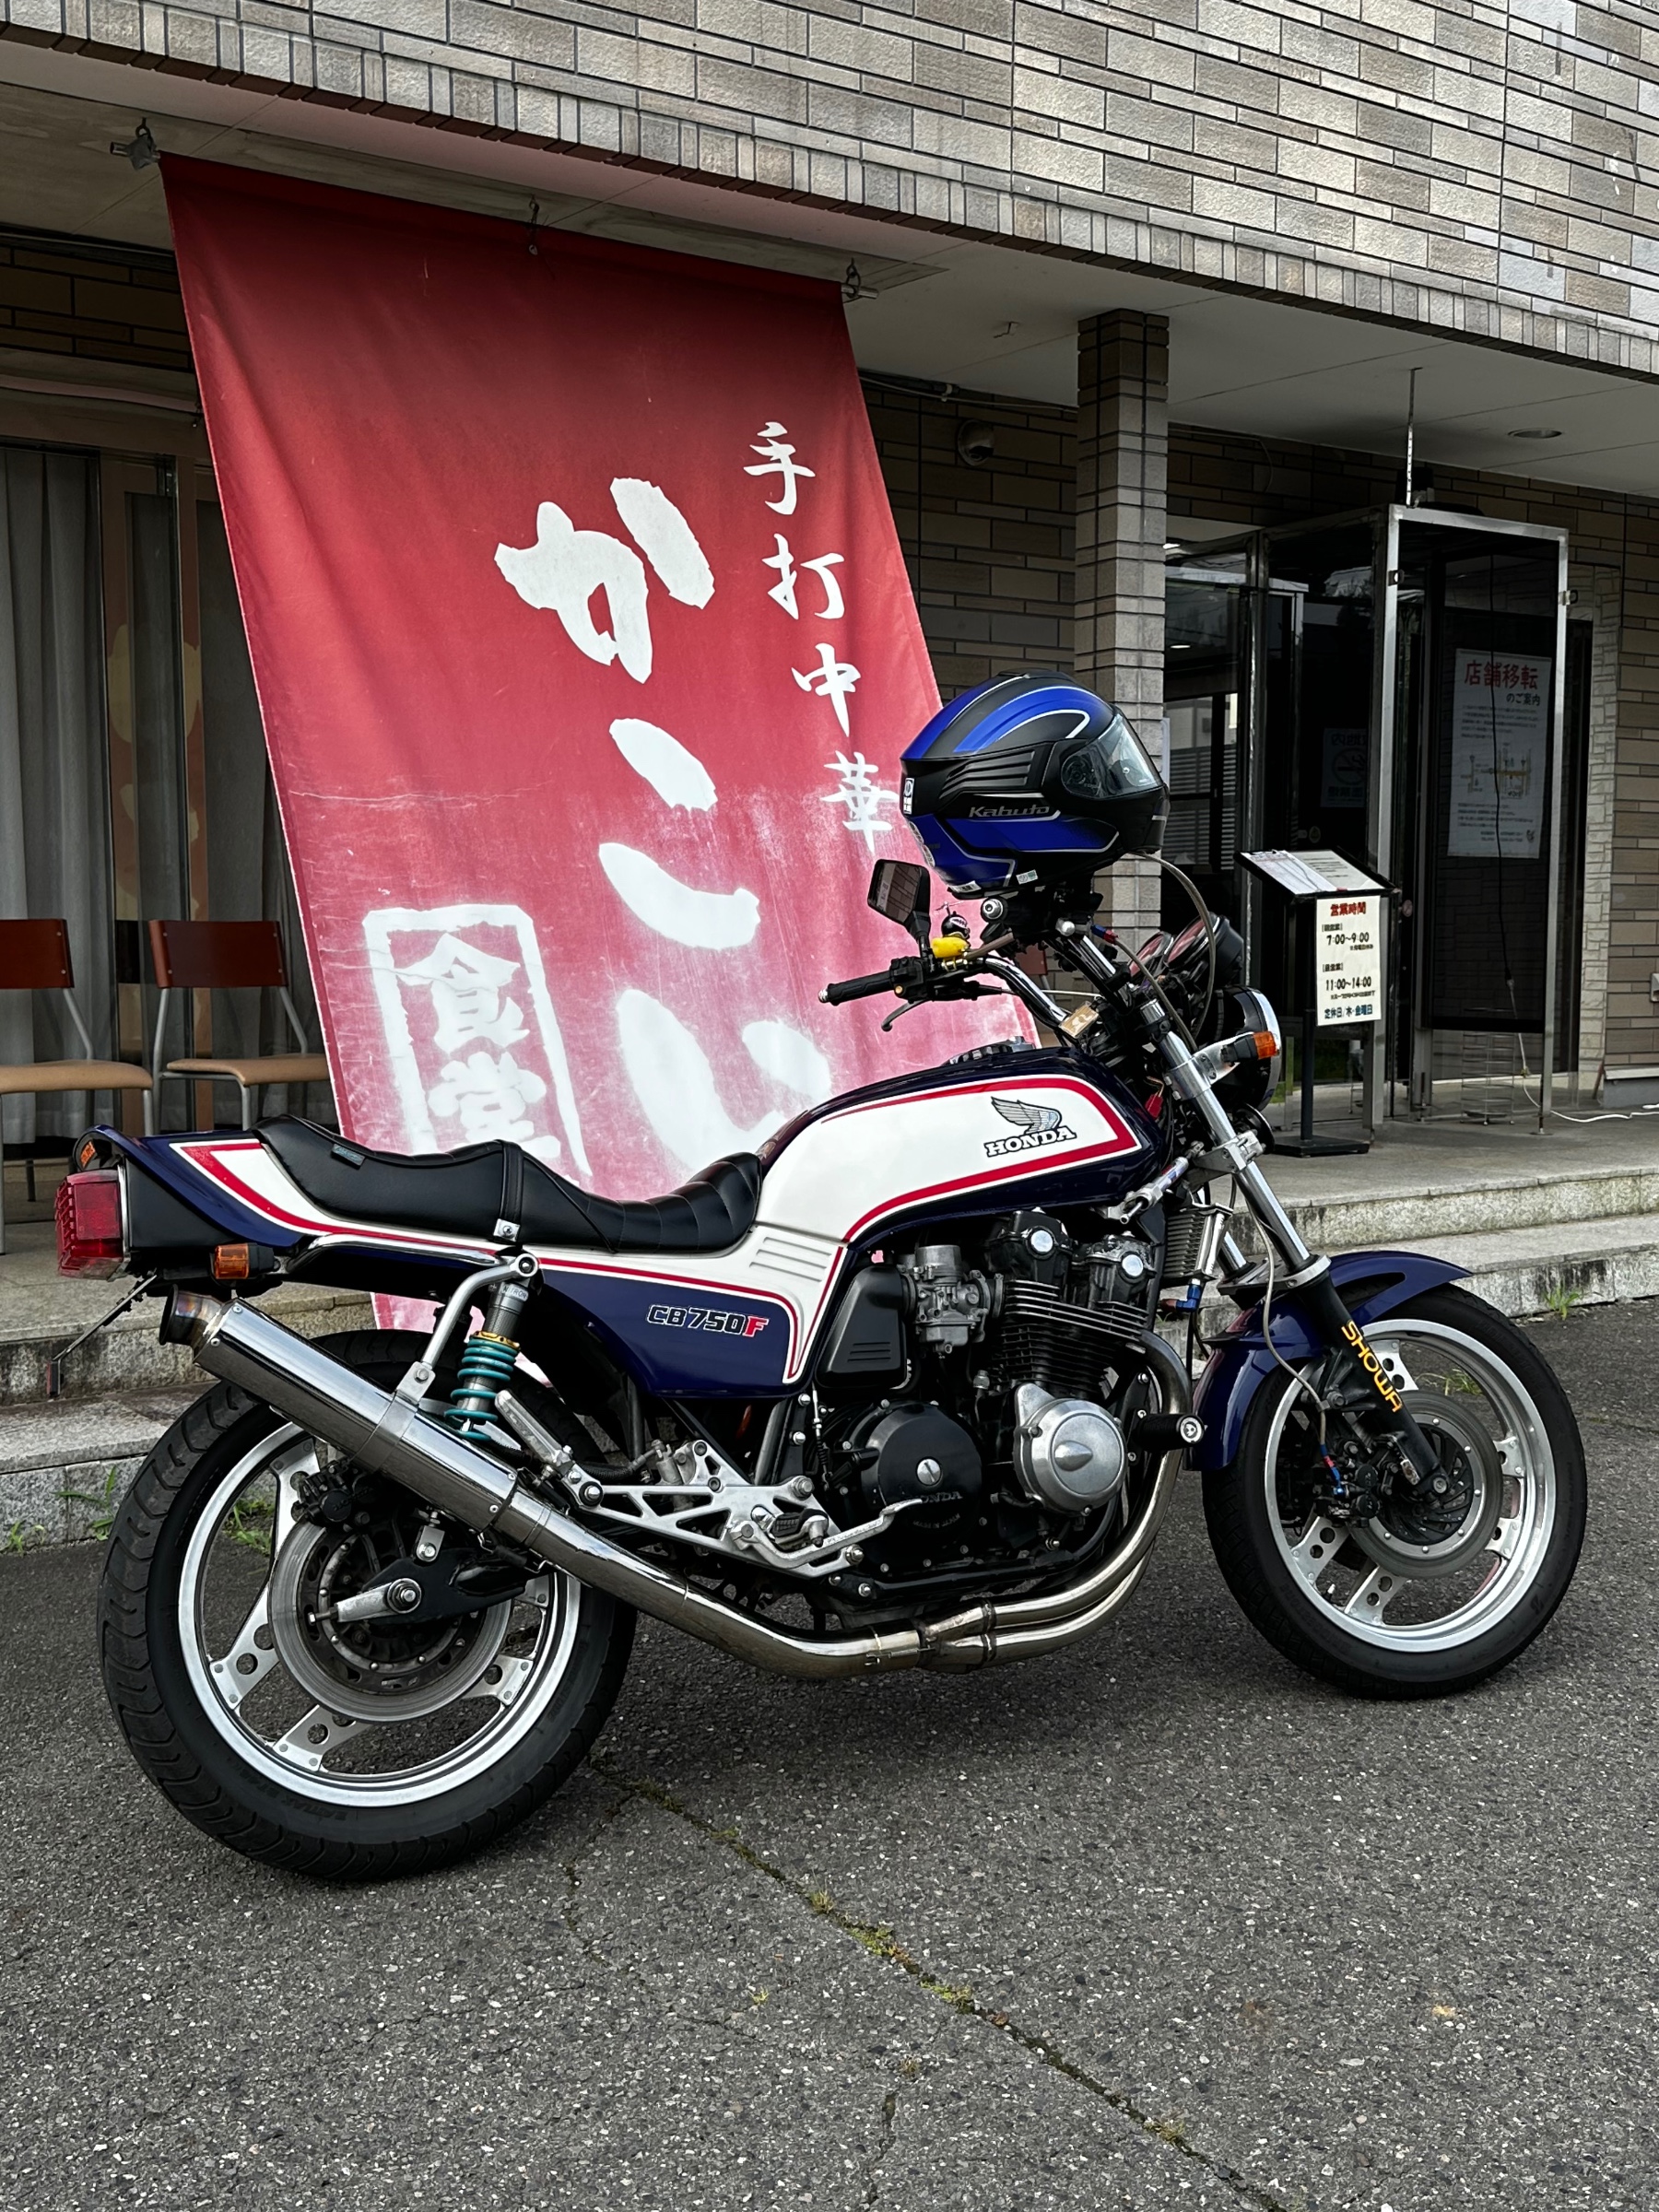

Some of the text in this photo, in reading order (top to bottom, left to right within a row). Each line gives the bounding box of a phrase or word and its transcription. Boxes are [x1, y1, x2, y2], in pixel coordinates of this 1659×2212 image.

[744, 422, 900, 854] 手打中華
[1465, 660, 1538, 690] 店舗移転
[1506, 692, 1541, 707] のご案内
[494, 477, 831, 1175] かこい
[969, 805, 1050, 818] Kabuto
[1330, 901, 1366, 916] 営業時間
[394, 933, 560, 1159] 食堂
[983, 1125, 1077, 1158] HONDA
[647, 1304, 770, 1337] CB750F
[1341, 1320, 1403, 1413] SHOWA
[912, 1490, 963, 1504] ONDA
